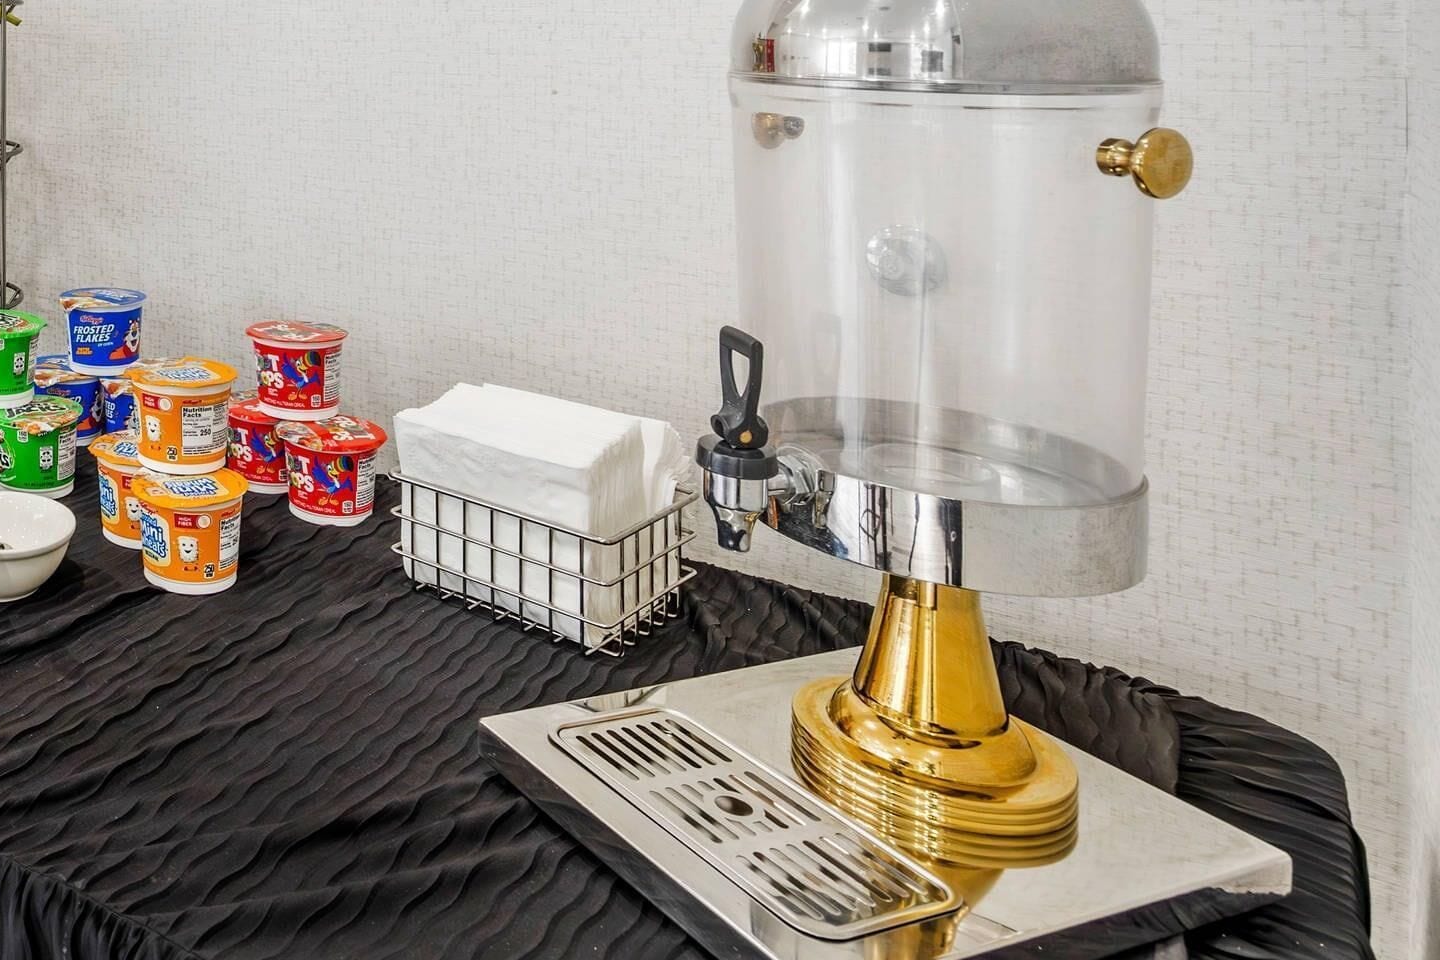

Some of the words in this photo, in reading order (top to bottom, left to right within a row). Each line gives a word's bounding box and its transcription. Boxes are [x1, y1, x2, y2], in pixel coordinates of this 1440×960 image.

[73, 324, 115, 335] FROSTED
[75, 333, 111, 343] FLAKES
[200, 429, 212, 437] 250
[167, 447, 178, 455] 250
[205, 564, 215, 573] 250
